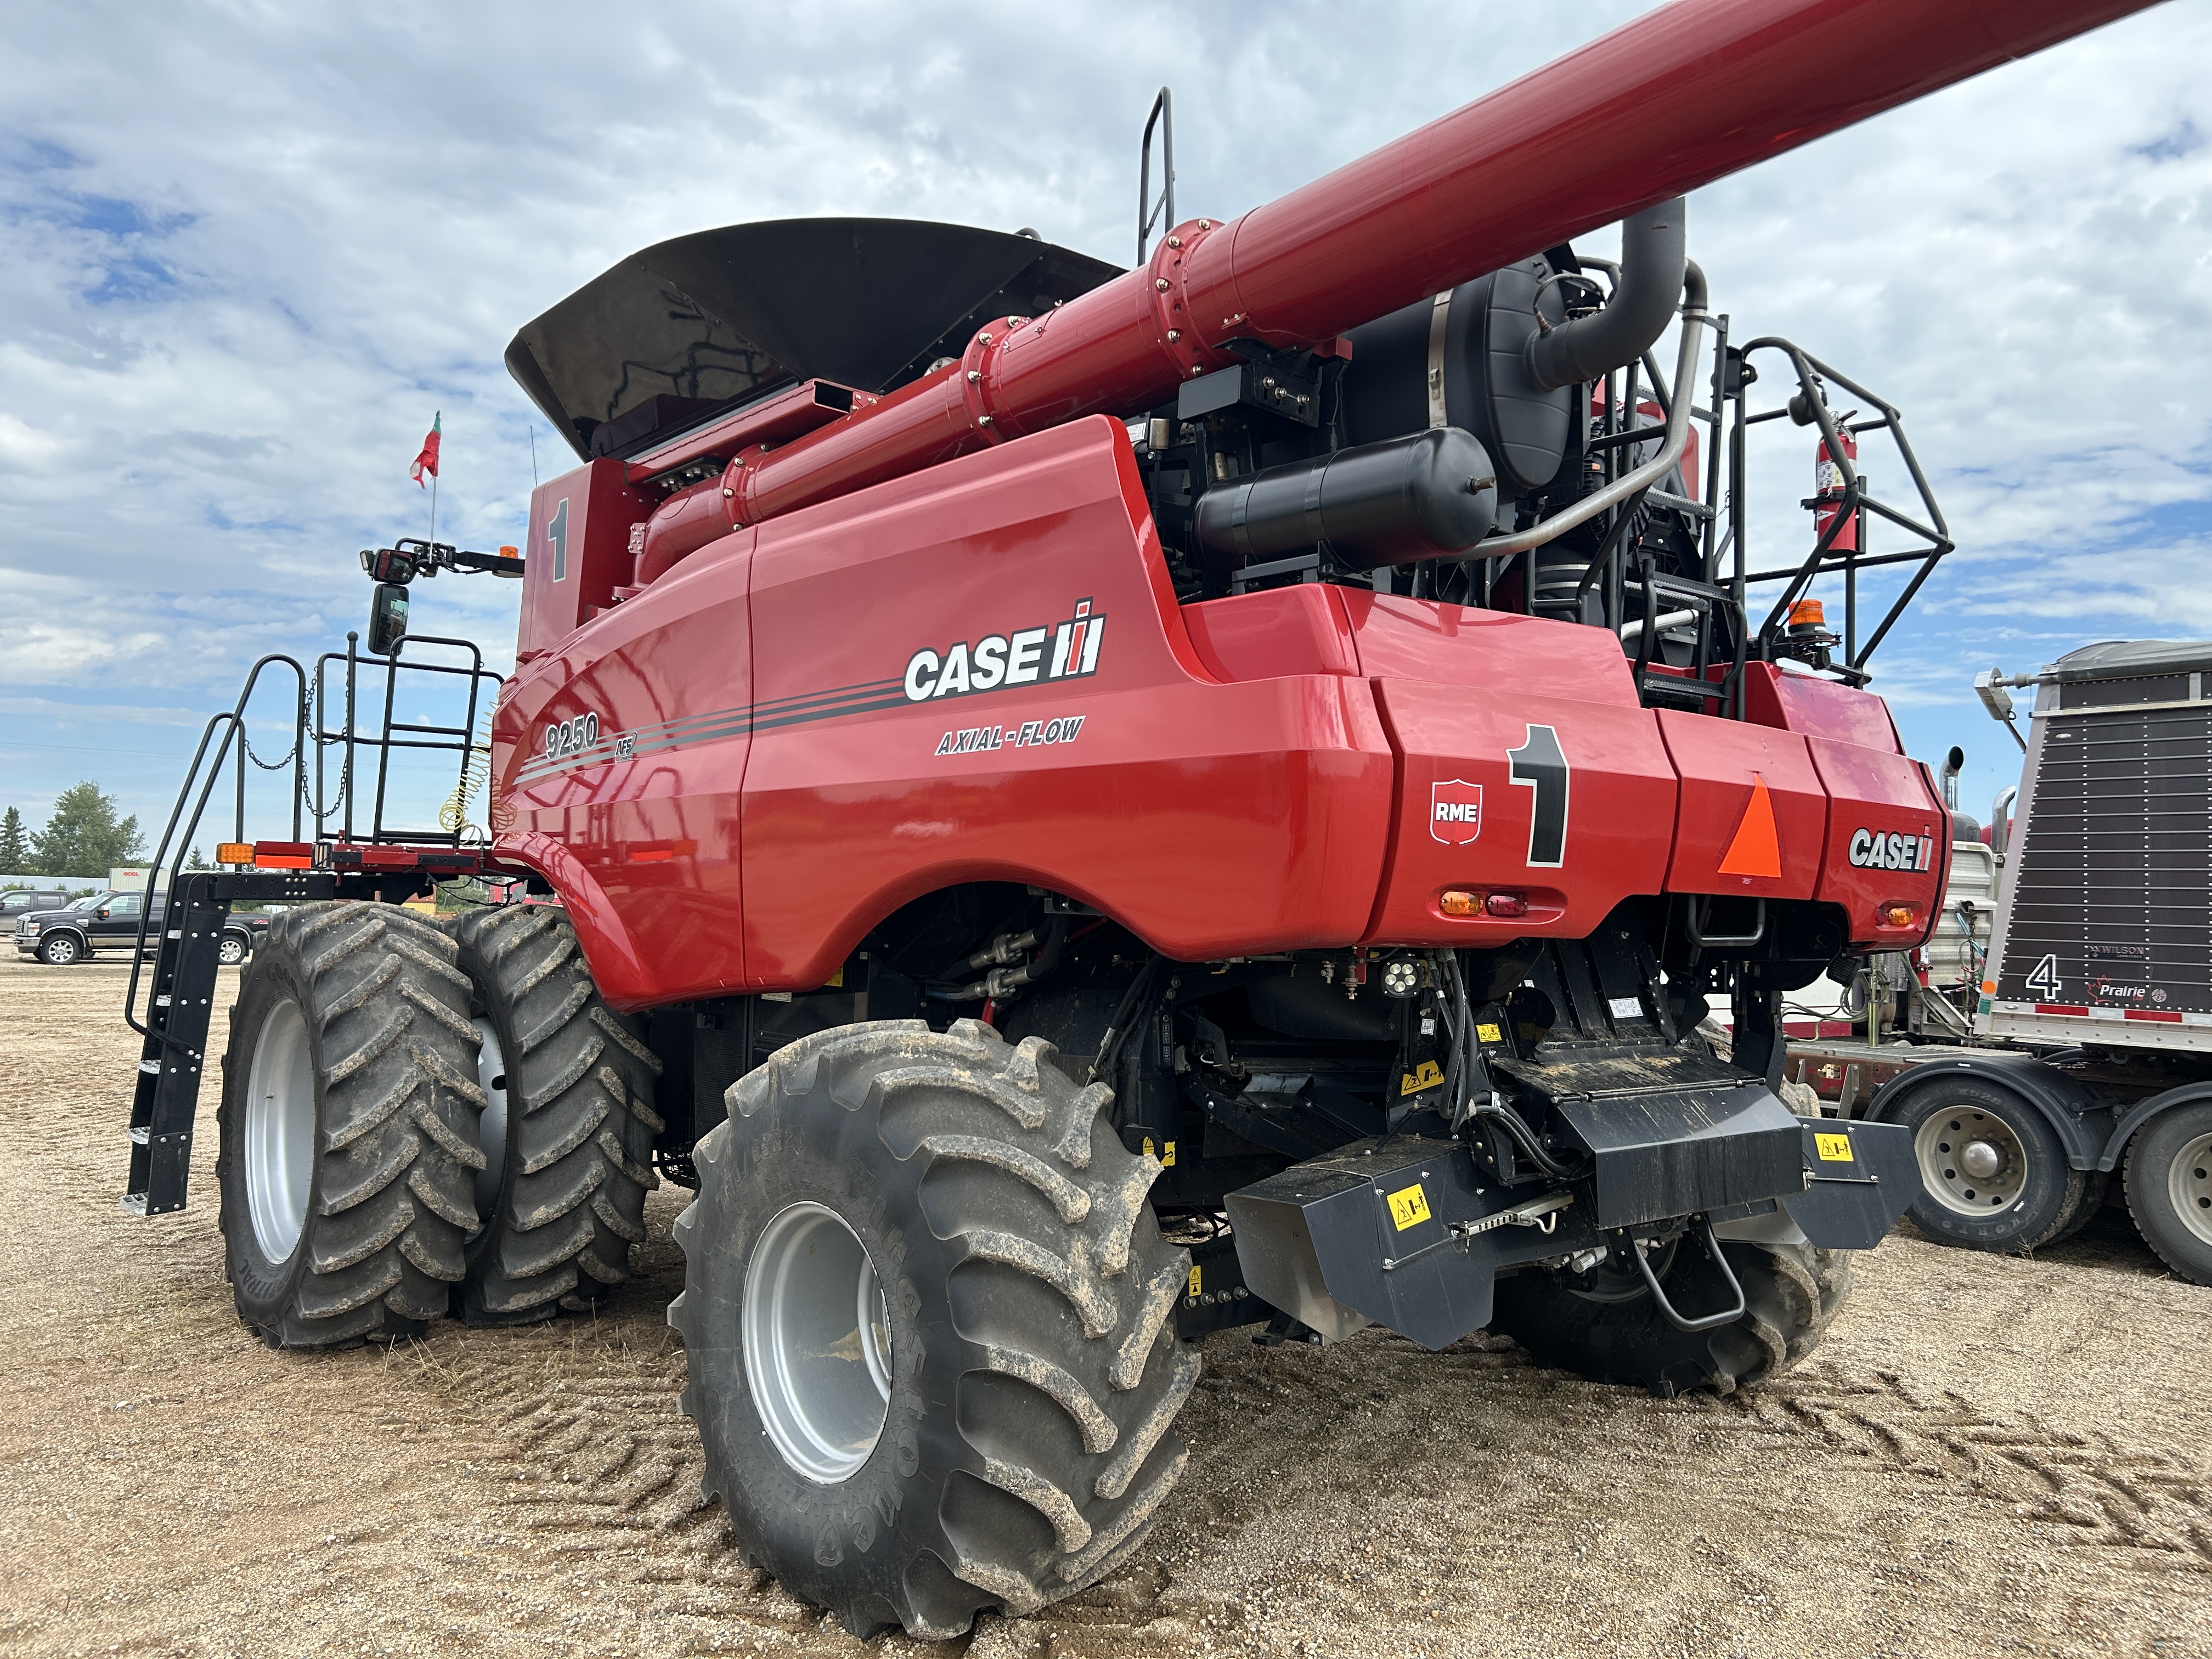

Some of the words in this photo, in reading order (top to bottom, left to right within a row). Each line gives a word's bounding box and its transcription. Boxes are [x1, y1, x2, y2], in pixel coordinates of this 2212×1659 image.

[549, 497, 569, 583] 1
[904, 627, 1047, 702] CASE
[546, 711, 599, 760] 9250
[614, 735, 634, 757] AFS
[1435, 803, 1478, 823] RME
[1505, 723, 1570, 868] 1
[1849, 827, 1916, 870] CASE
[2025, 953, 2062, 1000] 4
[2099, 984, 2146, 997] Prairie
